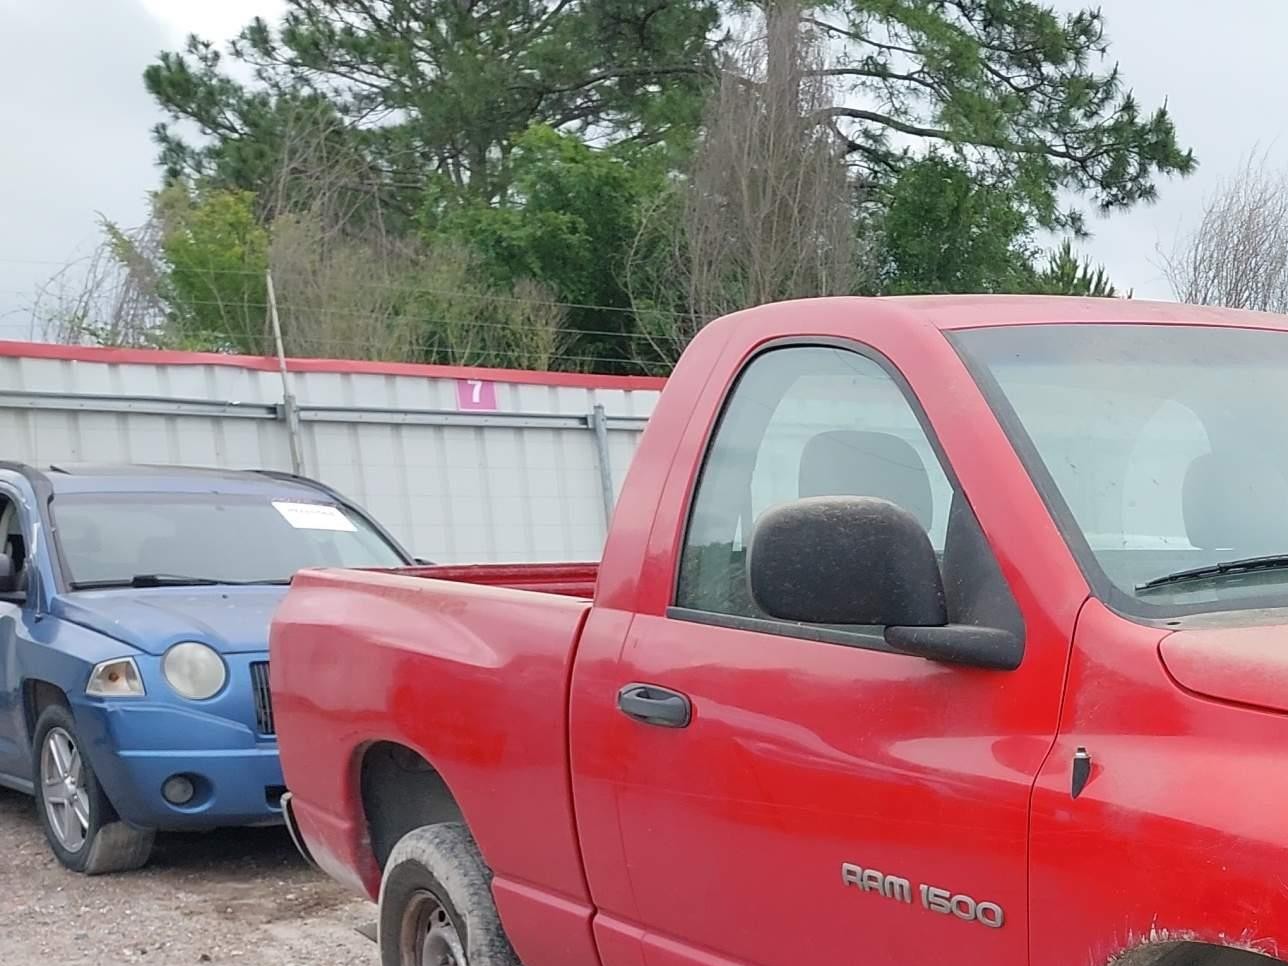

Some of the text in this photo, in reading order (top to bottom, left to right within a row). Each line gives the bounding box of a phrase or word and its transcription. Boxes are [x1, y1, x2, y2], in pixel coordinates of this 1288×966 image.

[467, 380, 482, 403] 7
[842, 862, 1004, 928] RAM 1500
